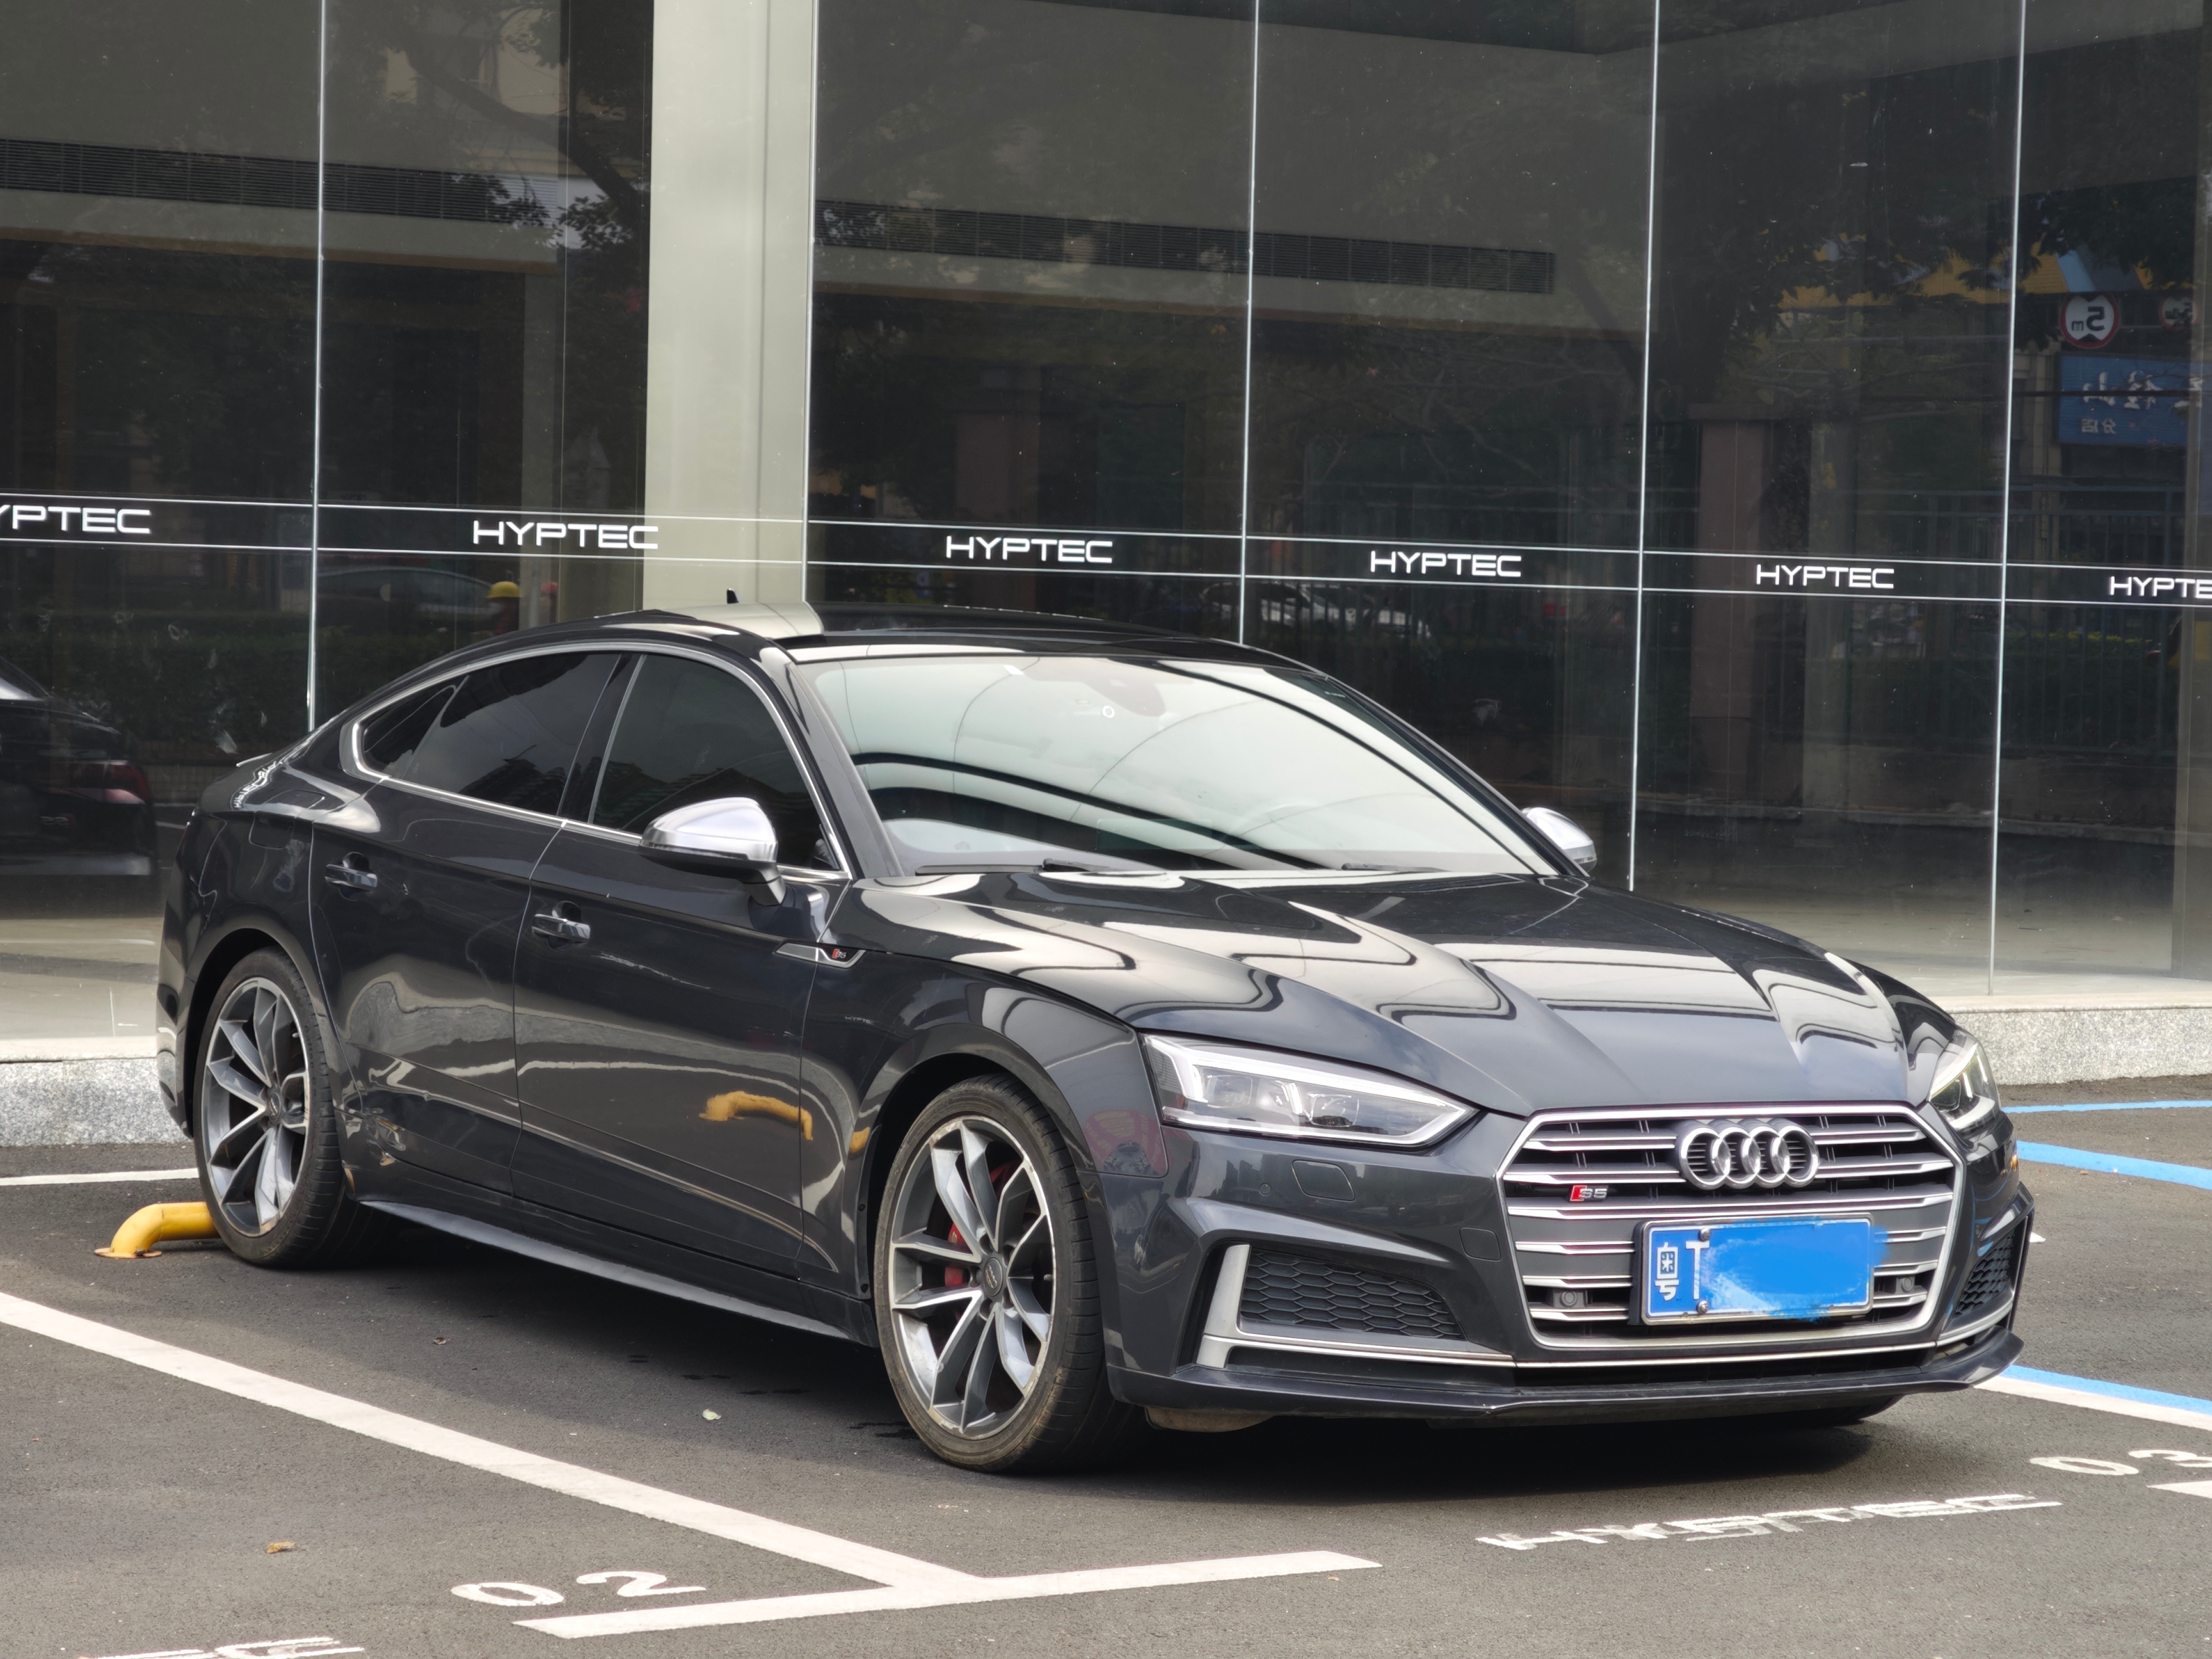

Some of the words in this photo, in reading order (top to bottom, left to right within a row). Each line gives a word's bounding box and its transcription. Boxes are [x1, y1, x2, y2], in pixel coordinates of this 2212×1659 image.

[473, 520, 658, 549] HYPTEC
[946, 535, 1113, 563] HYPTEC
[1370, 550, 1522, 577] HYPTEC
[1756, 564, 1894, 589] HYPTEC
[2110, 576, 2212, 599] HYPTE
[1579, 1188, 1608, 1199] S5
[2029, 1449, 2212, 1476] 03
[450, 1570, 707, 1607] 02
